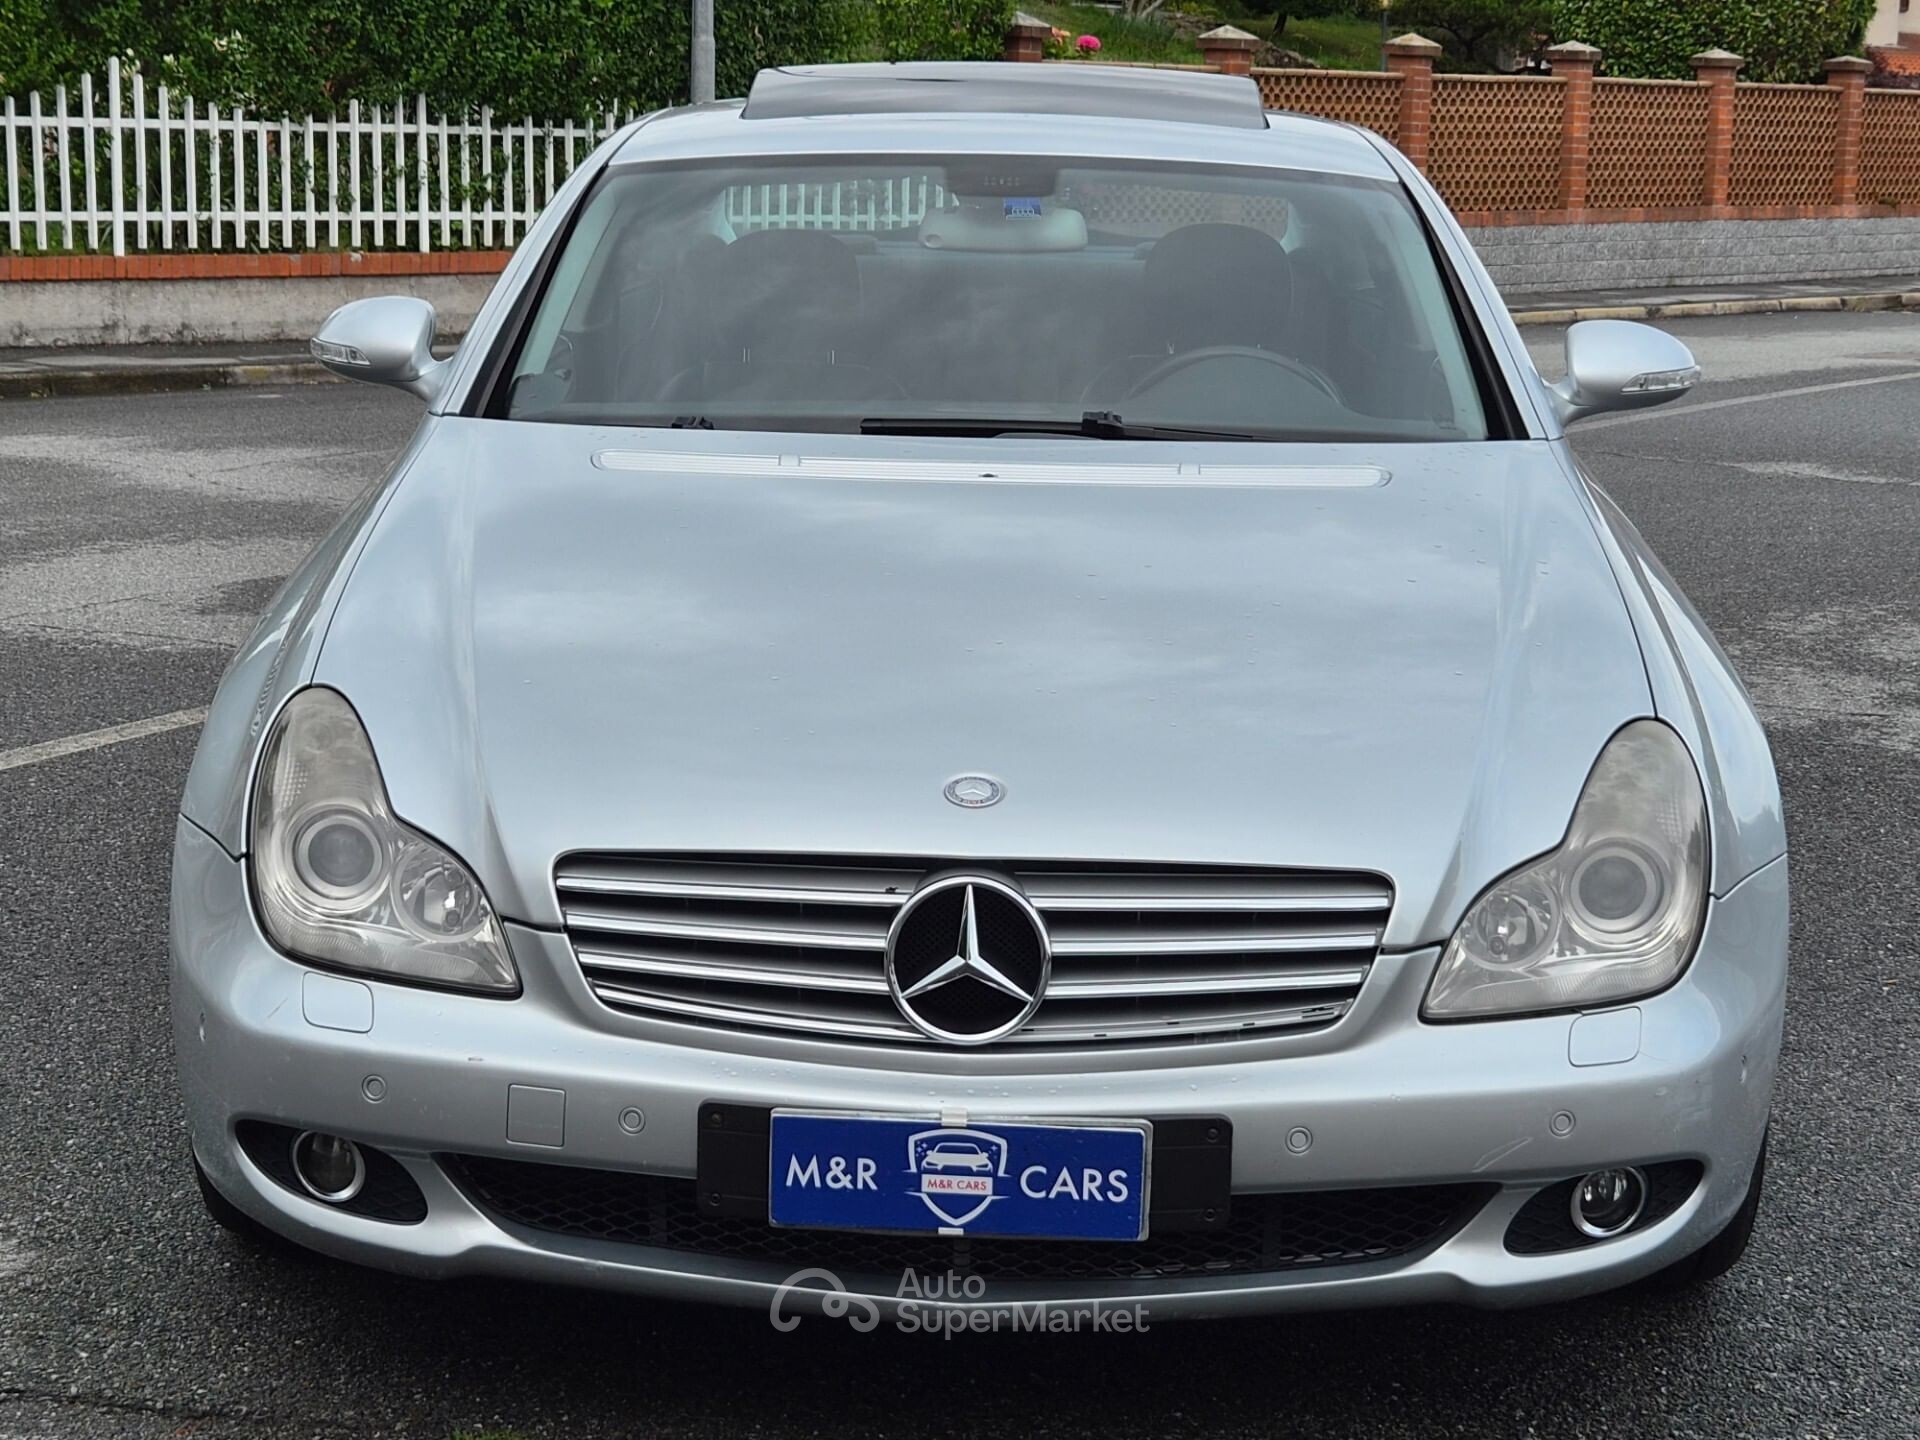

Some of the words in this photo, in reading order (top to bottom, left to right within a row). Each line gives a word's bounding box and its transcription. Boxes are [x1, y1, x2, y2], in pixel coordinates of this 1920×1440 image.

[786, 1154, 878, 1191] M&R
[1019, 1165, 1129, 1203] CARS
[927, 1178, 953, 1191] M&R
[956, 1179, 988, 1192] CARS
